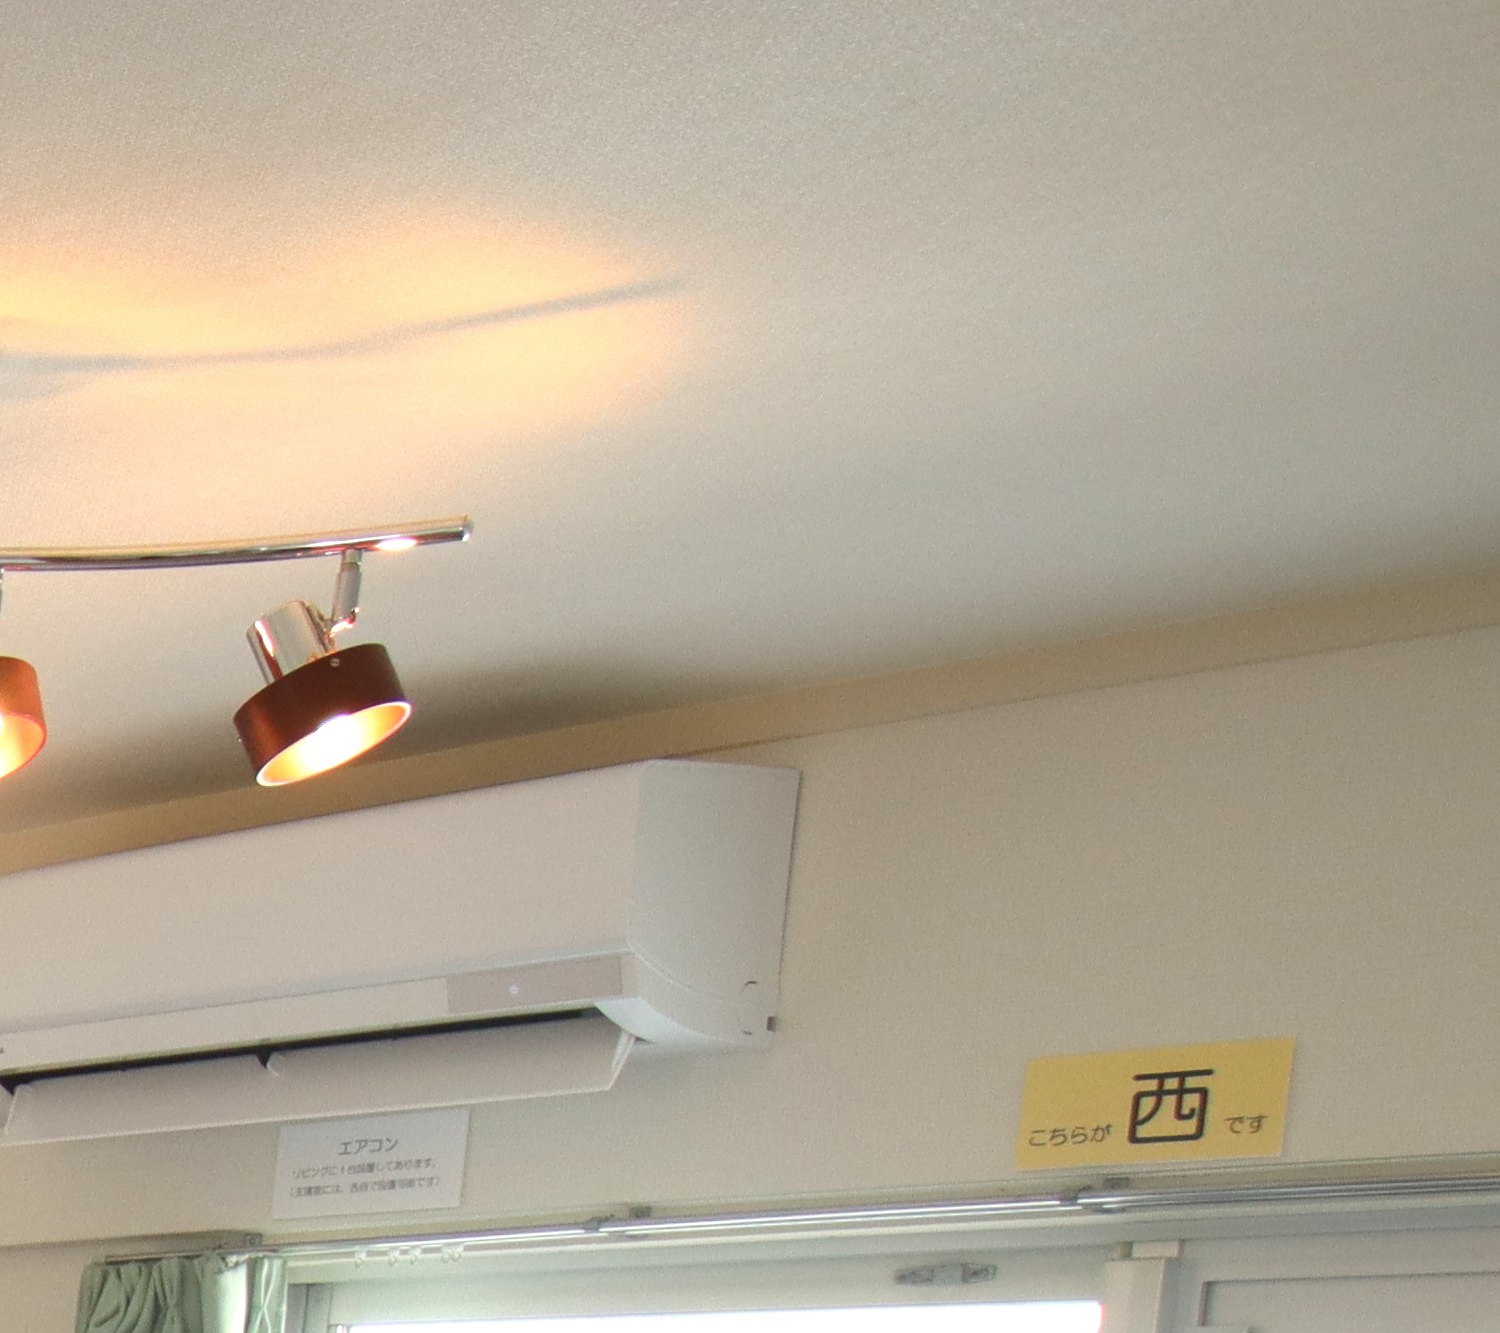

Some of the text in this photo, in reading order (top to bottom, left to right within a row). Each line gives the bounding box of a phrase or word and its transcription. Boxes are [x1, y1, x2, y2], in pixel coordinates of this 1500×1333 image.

[1027, 1068, 1269, 1147] こちらが 西 です
[337, 1138, 399, 1156] エアコン
